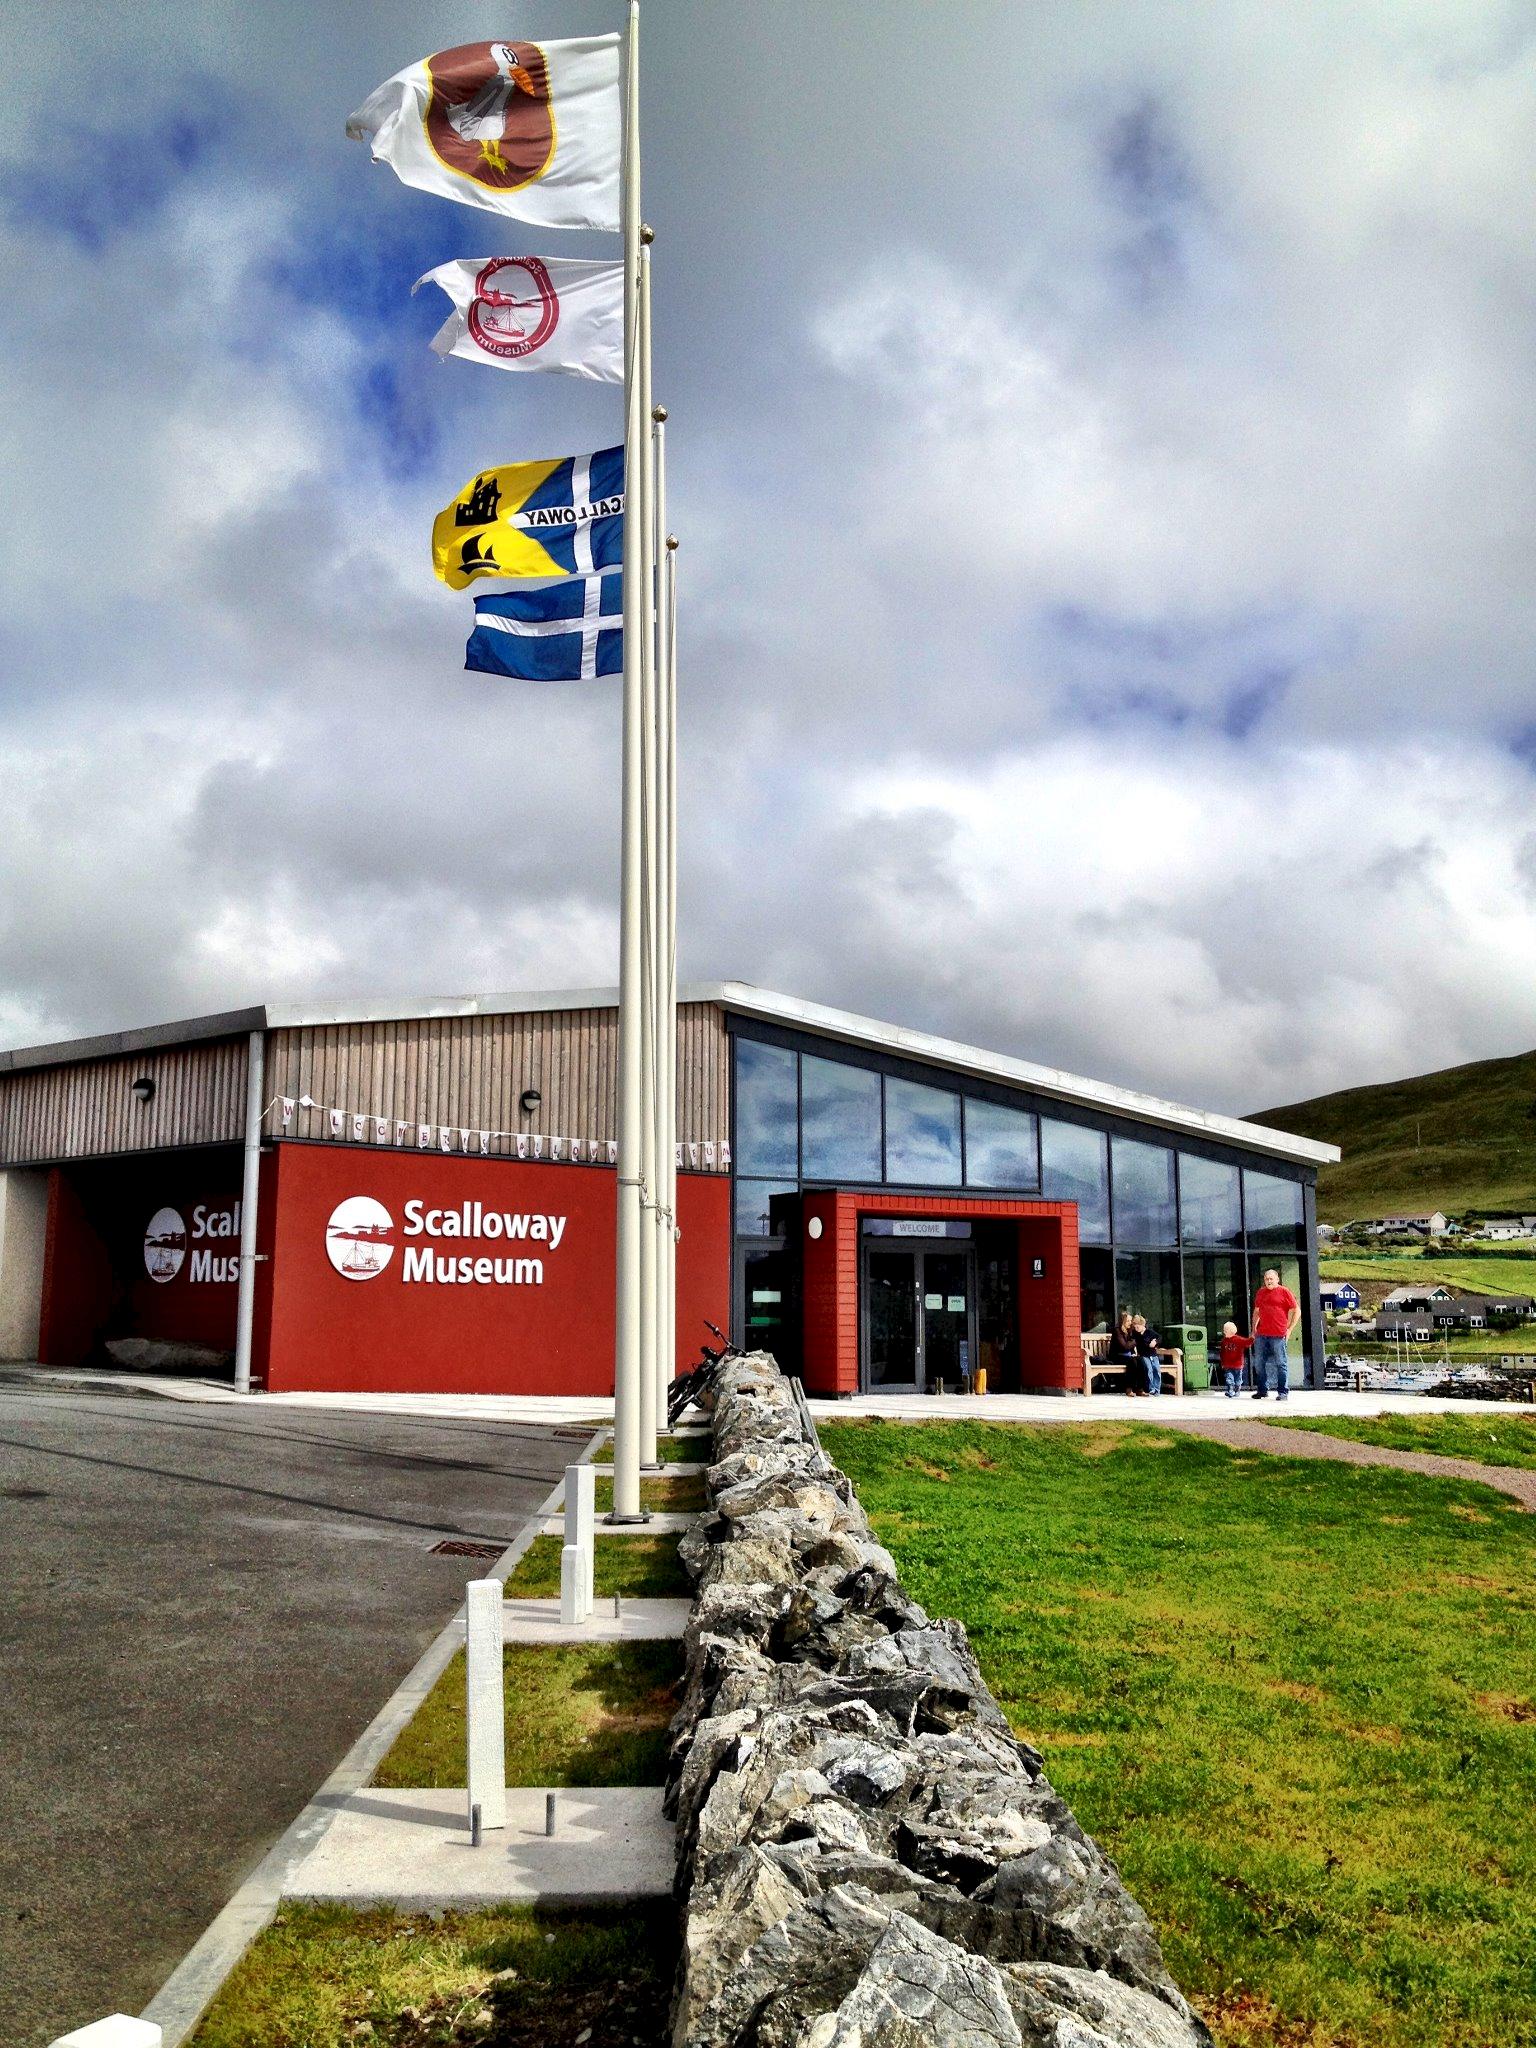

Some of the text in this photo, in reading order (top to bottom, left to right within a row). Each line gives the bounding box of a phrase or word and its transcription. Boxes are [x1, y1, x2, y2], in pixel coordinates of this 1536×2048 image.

[403, 1199, 567, 1250] Scalloway
[900, 1223, 940, 1234] WELCOME
[189, 1249, 240, 1283] Mus
[402, 1246, 544, 1284] Museum
